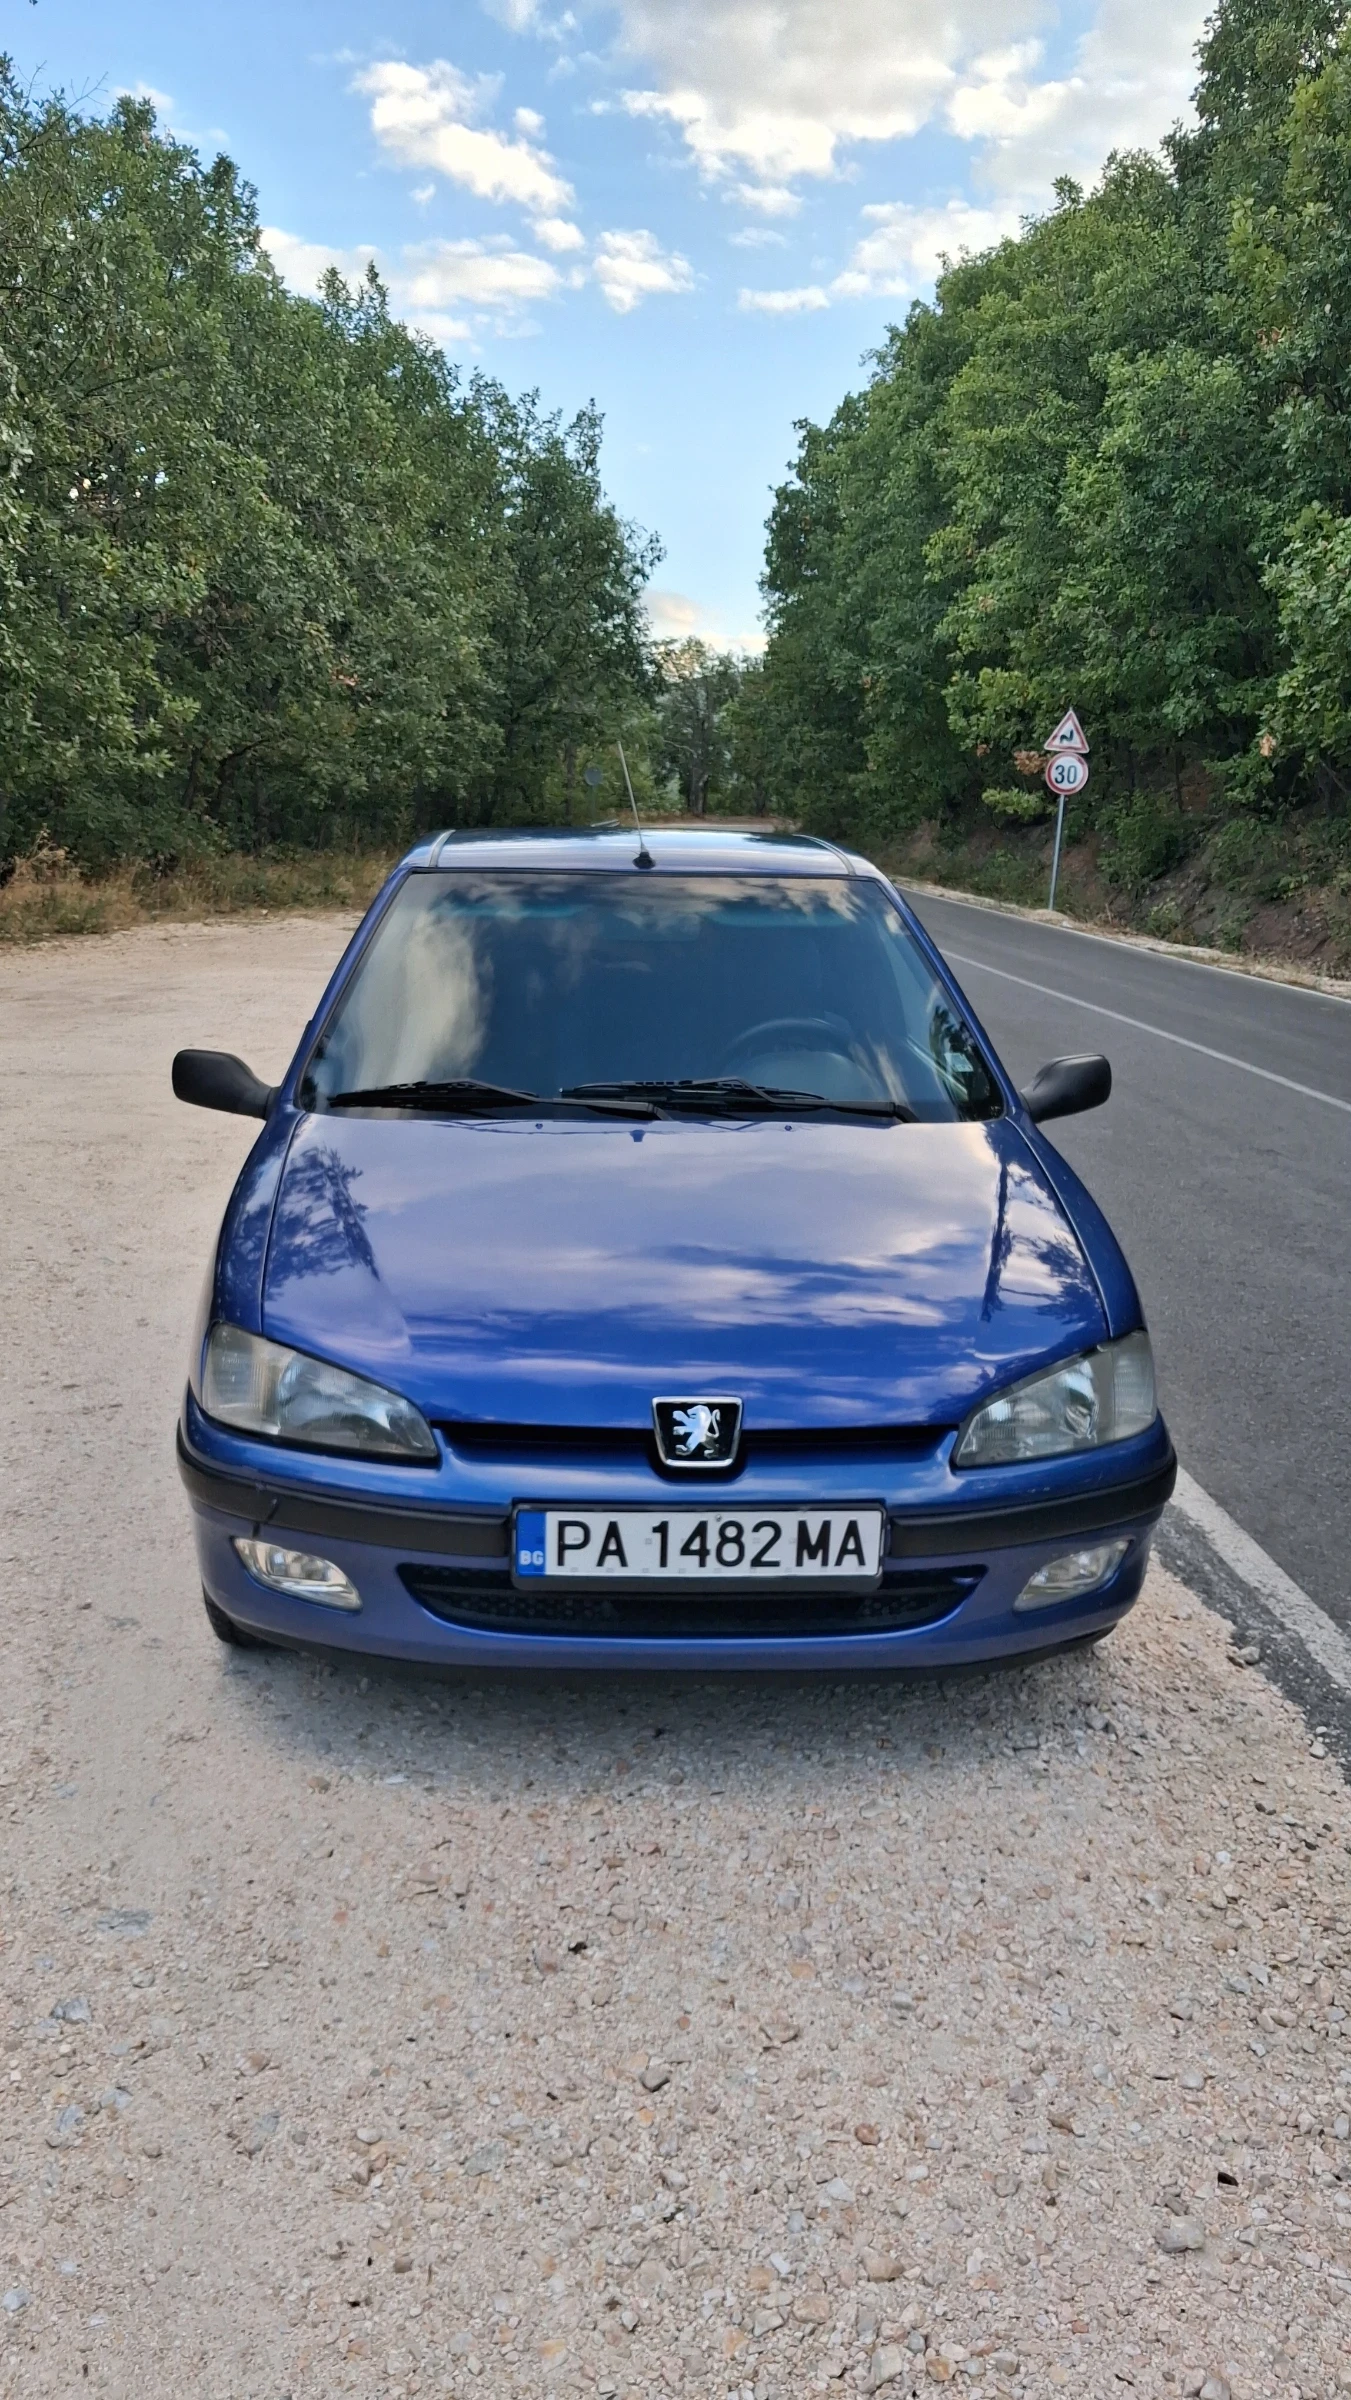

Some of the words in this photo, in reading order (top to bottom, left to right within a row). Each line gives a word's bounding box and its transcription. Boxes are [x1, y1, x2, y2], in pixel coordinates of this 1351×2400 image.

[1054, 764, 1077, 784] 30
[556, 1520, 628, 1567] PA
[652, 1520, 782, 1567] 1482
[795, 1520, 866, 1567] MA
[519, 1551, 544, 1565] BG
